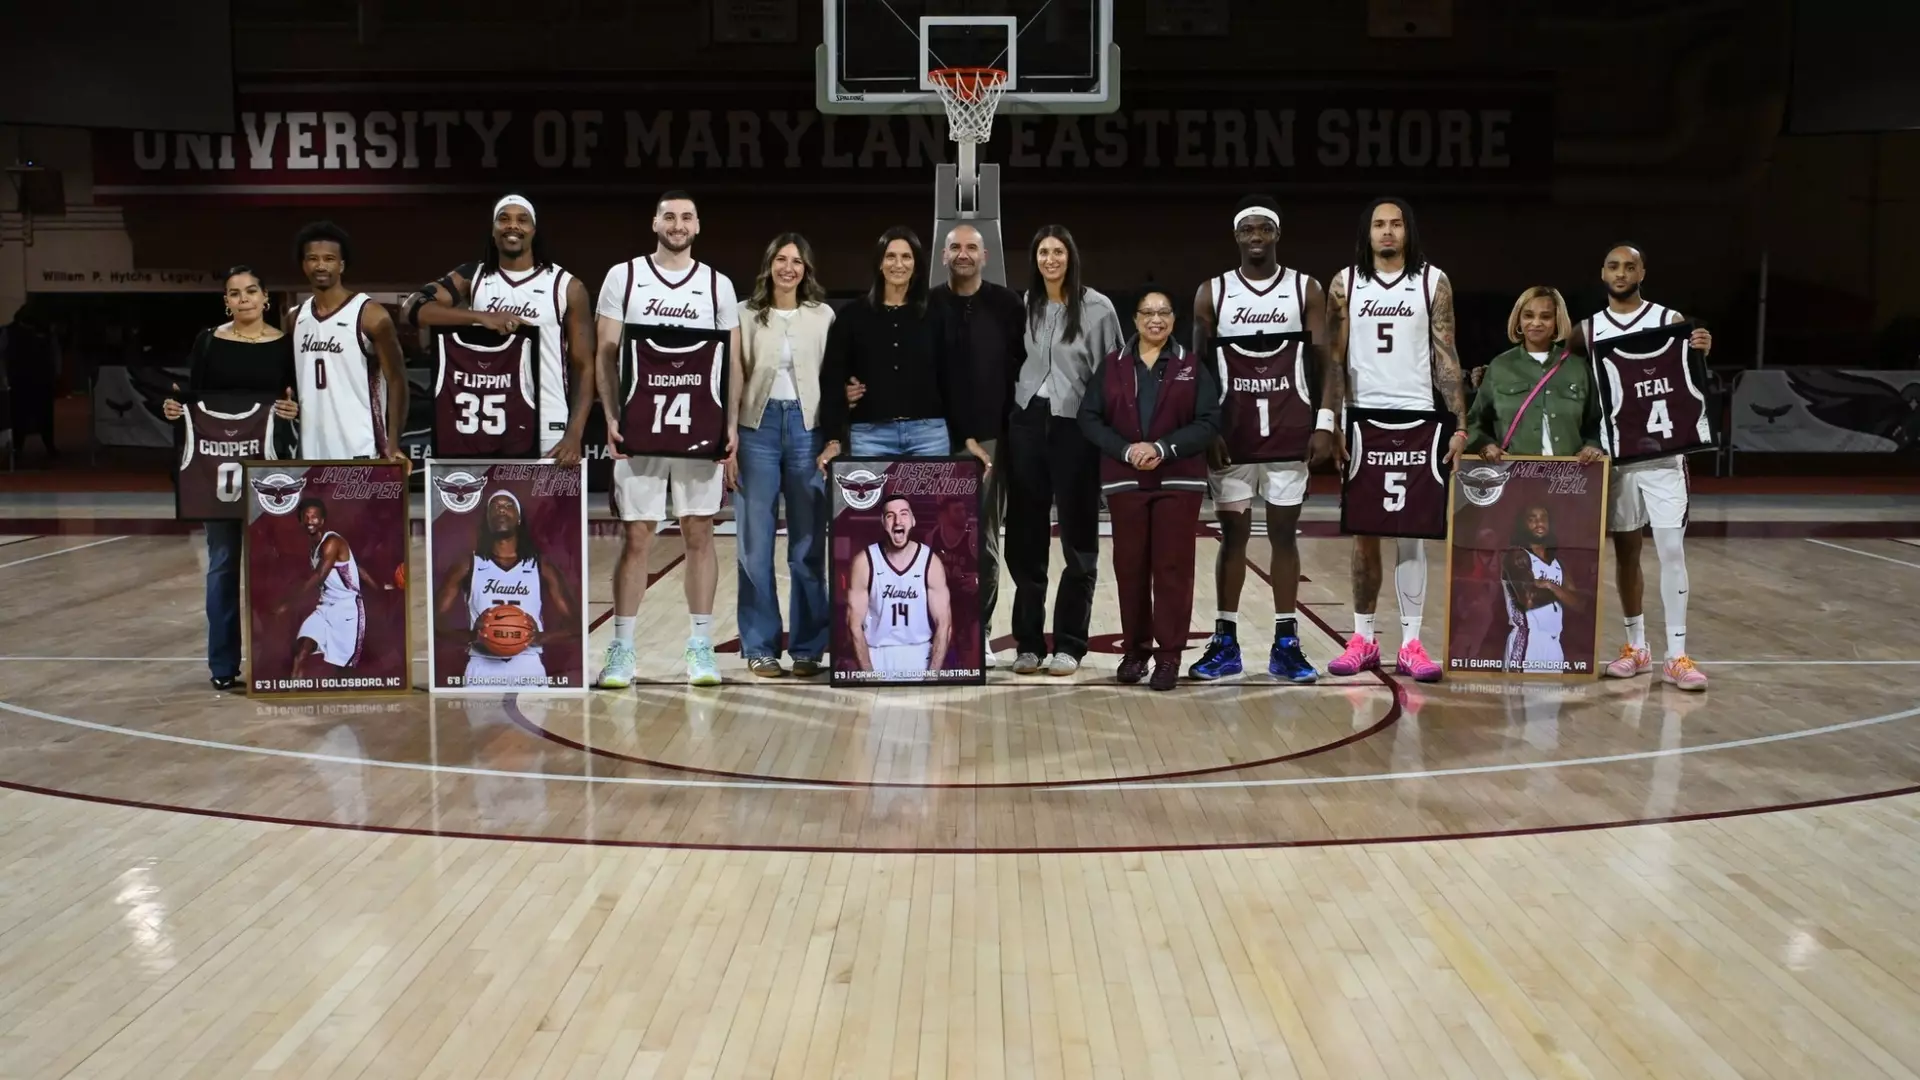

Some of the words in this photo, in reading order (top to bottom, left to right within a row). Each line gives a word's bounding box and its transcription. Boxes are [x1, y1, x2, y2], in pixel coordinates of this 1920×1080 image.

[836, 94, 864, 102] SPALDING
[133, 109, 513, 171] UNIVERSITY
[533, 109, 603, 168] OF
[624, 108, 988, 168] MARYLAN
[1008, 108, 1297, 168] EASTERN
[1317, 107, 1512, 168] SHORE
[642, 298, 700, 320] Hawks
[1230, 307, 1289, 325] Hawks
[1357, 299, 1415, 318] Hawks
[300, 333, 344, 353] Hawks
[1377, 323, 1394, 353] 5
[315, 358, 327, 390] 0
[453, 371, 512, 389] FLIPPIN
[647, 373, 702, 388] LOCANDRO
[1233, 375, 1290, 394] OBANLA
[1634, 377, 1674, 399] TEAL
[454, 391, 507, 436] 35
[651, 392, 692, 435] 14
[1255, 398, 1270, 438] 1
[1646, 399, 1674, 439] 4
[199, 439, 260, 457] COOPER
[1366, 450, 1427, 467] STAPLES
[313, 466, 373, 484] JADEN
[889, 462, 955, 480] JOSEPH
[1510, 461, 1583, 479] MICHAEL
[216, 462, 243, 503] 0
[332, 482, 403, 500] COOPER
[531, 480, 580, 497] FLIPPIN
[892, 478, 978, 496] LOCANDRO
[1548, 476, 1588, 494] TEAL
[1383, 472, 1407, 513] 5
[482, 578, 530, 596] Hawks
[882, 584, 919, 599] Hawks
[891, 602, 909, 627] 14
[1470, 659, 1503, 669] GUARD
[1510, 660, 1572, 670] ALEXANDRIA,
[1574, 661, 1587, 670] VA
[278, 678, 314, 690] GUARD
[321, 677, 385, 689] GOLDSBORO,
[386, 676, 401, 688] NC
[466, 675, 508, 686] FORWARD
[557, 676, 569, 686] LA
[851, 670, 887, 680] FORWARD
[939, 668, 980, 678] AUSTRALIA
